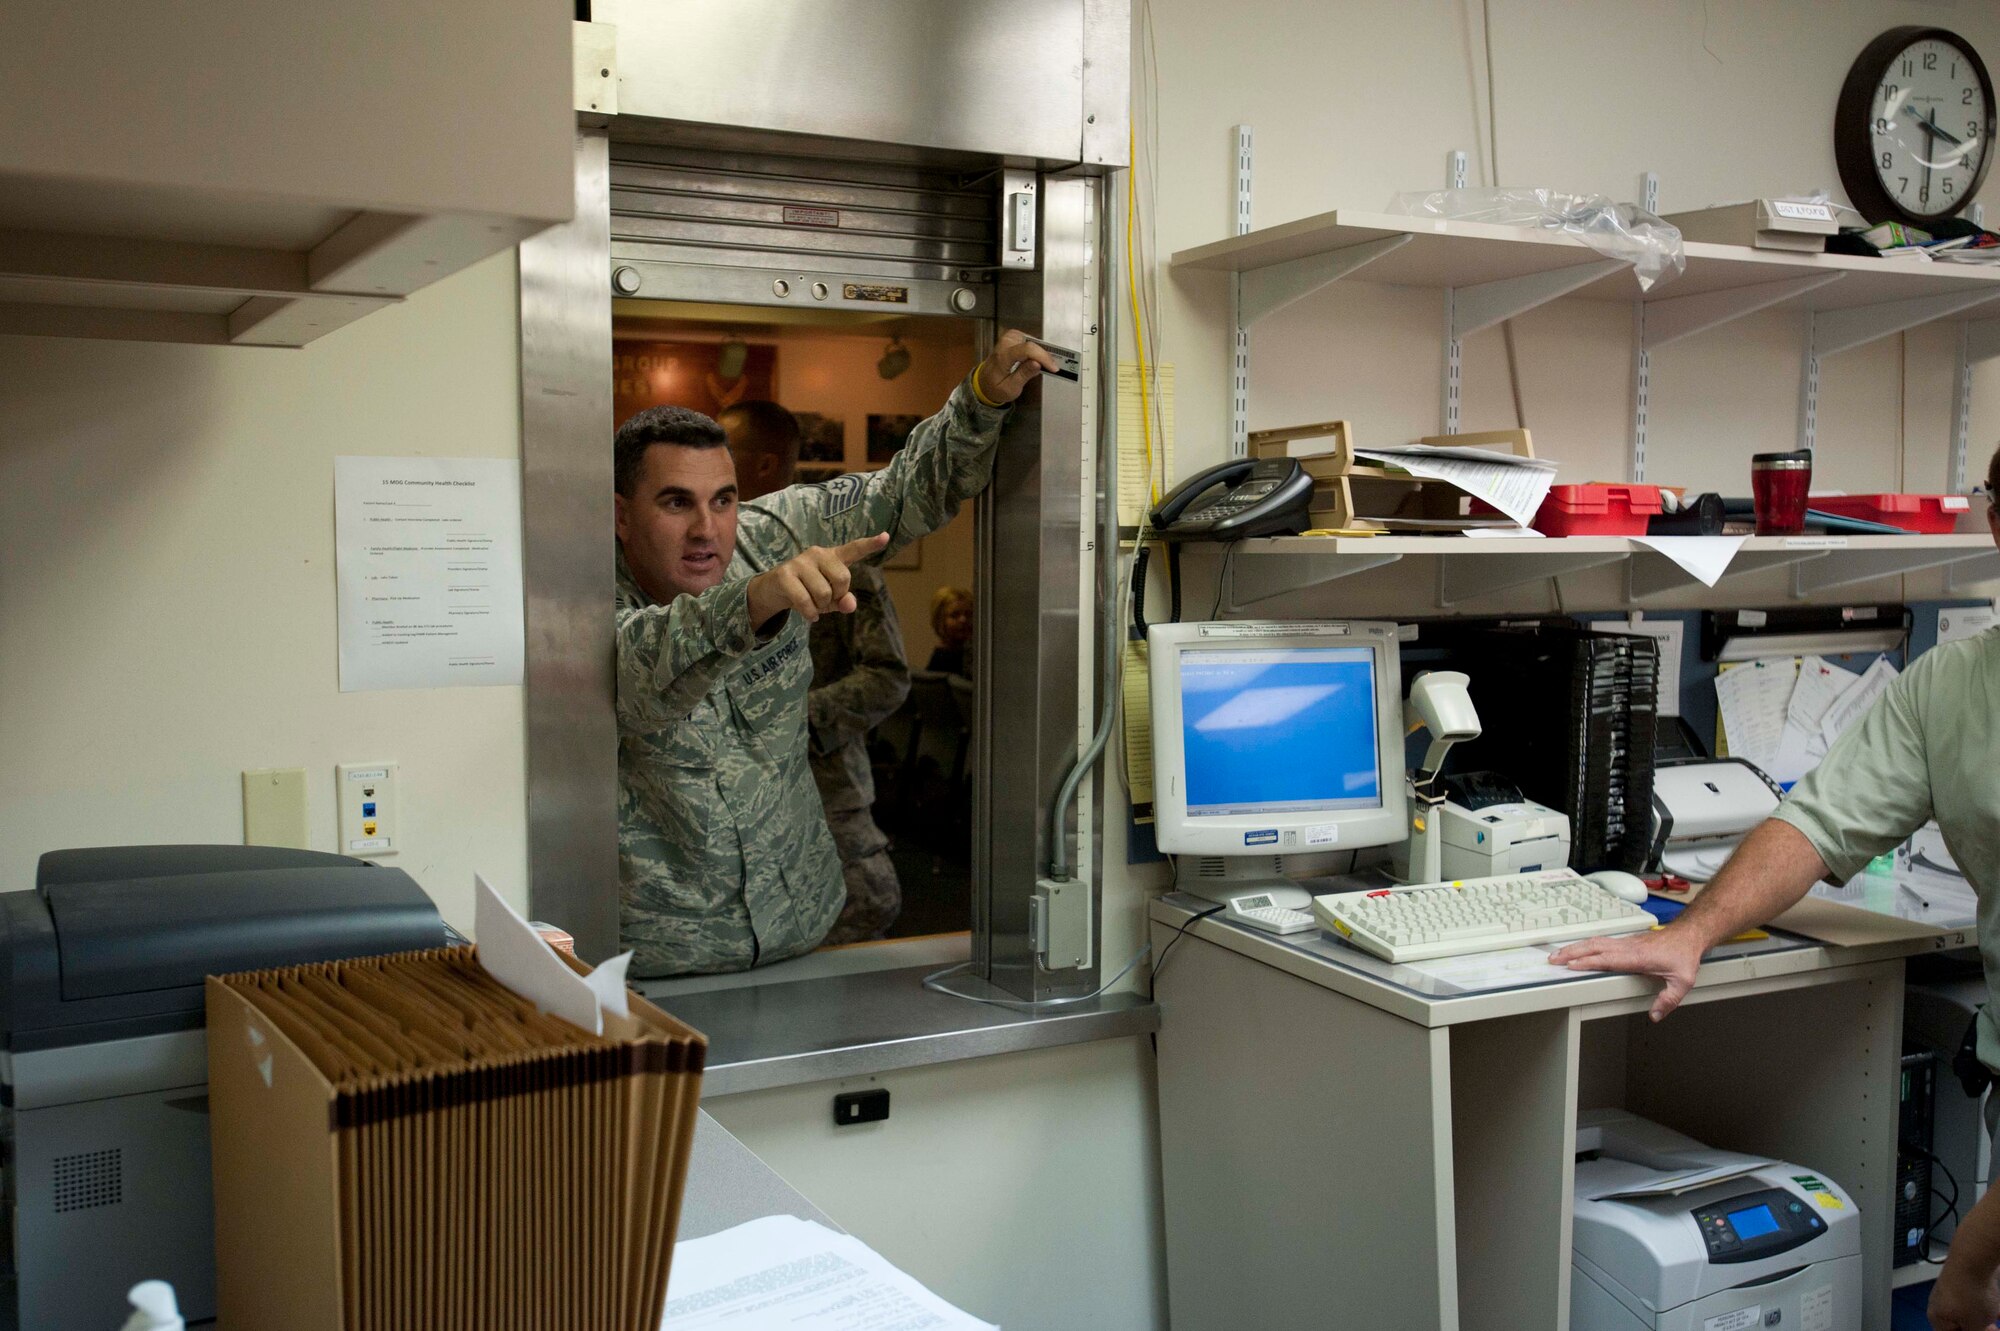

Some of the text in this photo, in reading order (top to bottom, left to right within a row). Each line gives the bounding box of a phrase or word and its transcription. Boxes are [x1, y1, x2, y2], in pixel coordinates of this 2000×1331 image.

[1902, 60, 1913, 78] 11
[1923, 53, 1937, 71] 12
[1951, 62, 1955, 80] 1
[1884, 84, 1898, 102] 10
[1962, 87, 1973, 105] 2
[1876, 117, 1888, 136] 9
[1966, 121, 1977, 138] 3
[1881, 152, 1892, 170] 8
[1959, 153, 1970, 169] 4
[1898, 177, 1908, 194] 7
[1919, 185, 1929, 203] 6
[1942, 177, 1953, 194] 5
[1090, 324, 1098, 335] 6
[1086, 541, 1095, 551] 5
[761, 656, 780, 675] AIR
[776, 637, 799, 664] FORCE
